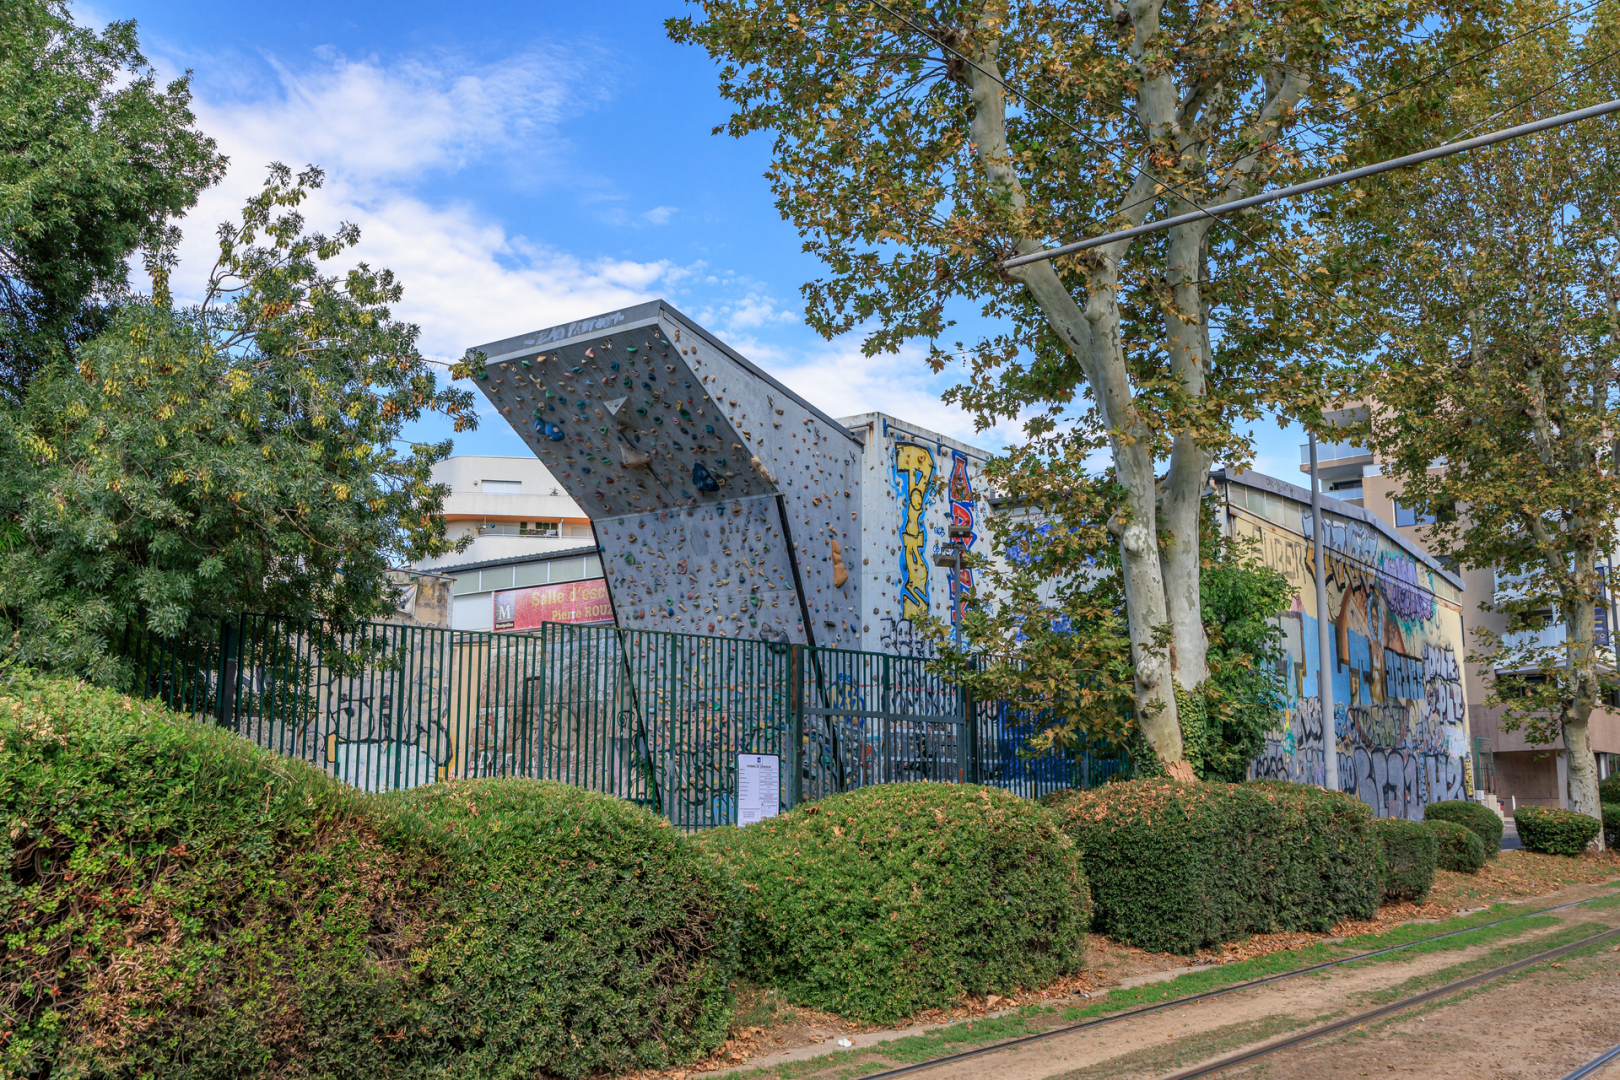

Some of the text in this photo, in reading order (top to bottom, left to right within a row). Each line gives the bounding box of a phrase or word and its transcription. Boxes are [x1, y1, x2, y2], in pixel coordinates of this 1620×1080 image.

[532, 591, 564, 606] Salle
[498, 605, 511, 620] M
[552, 609, 582, 621] Pierre
